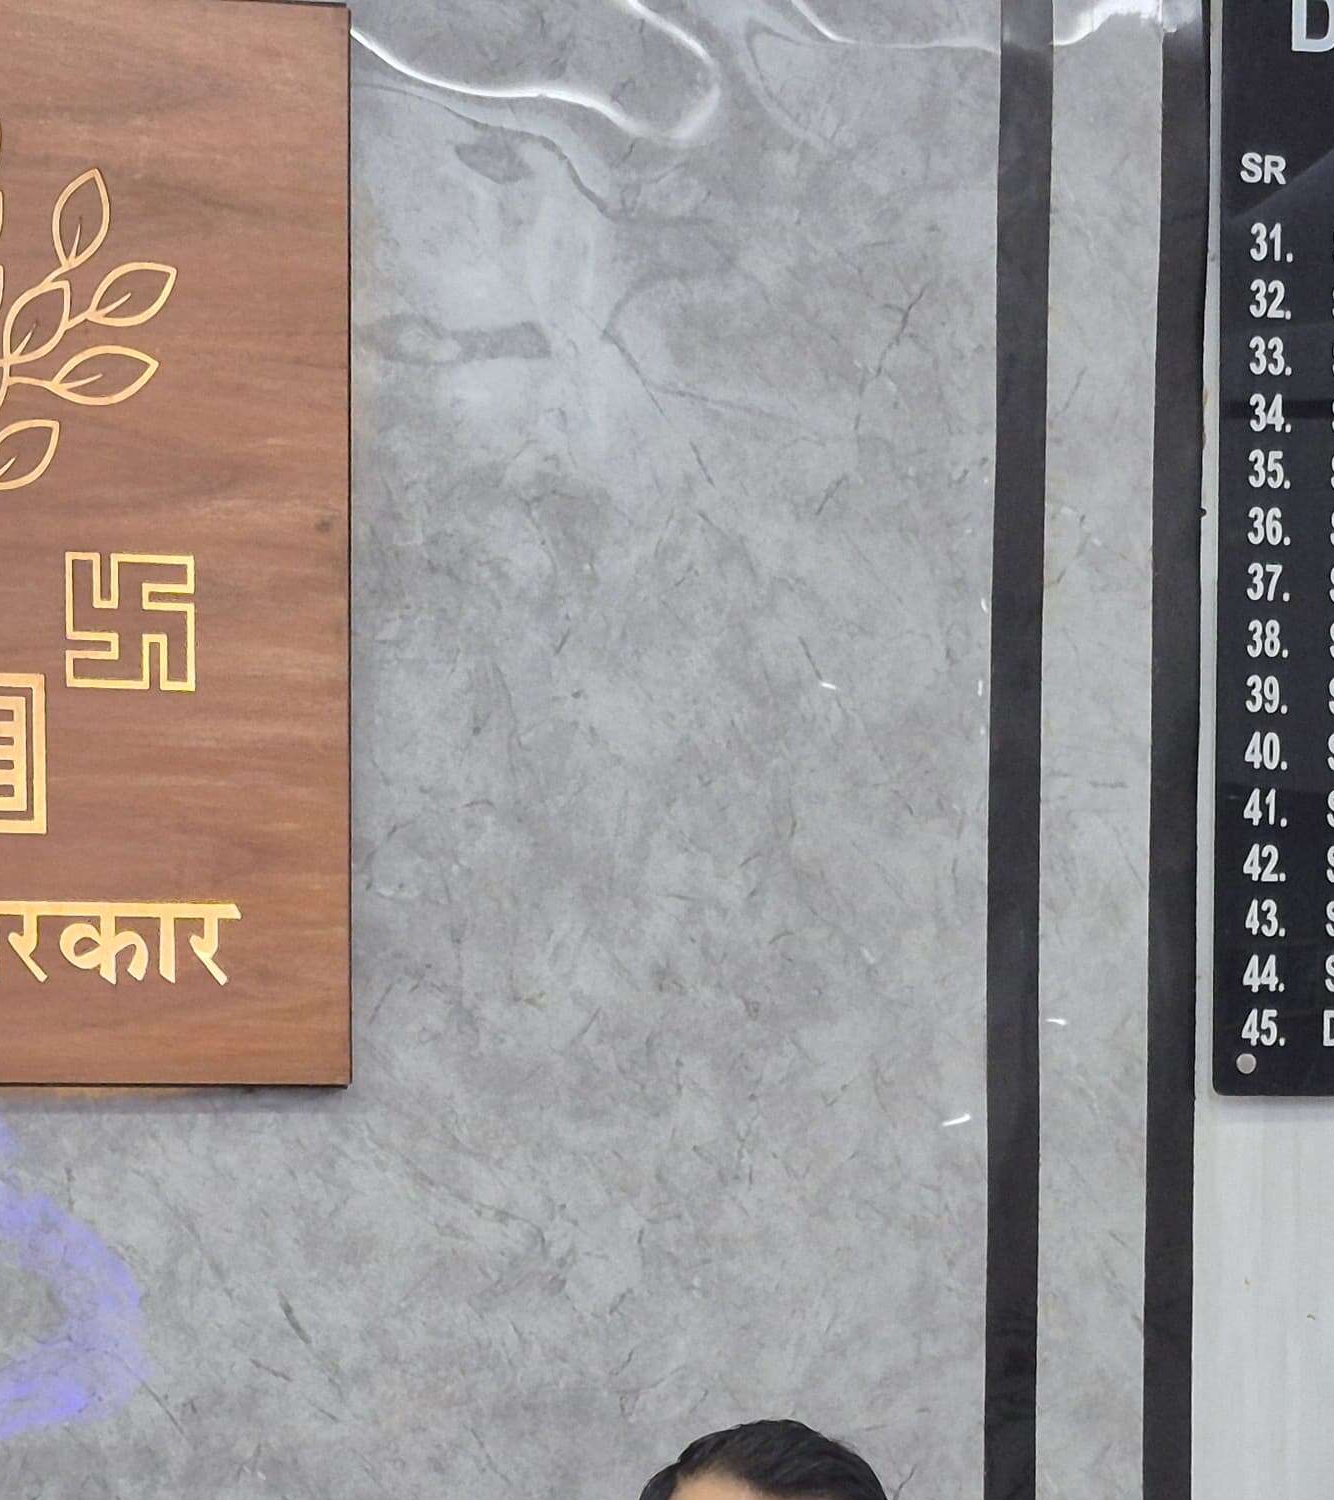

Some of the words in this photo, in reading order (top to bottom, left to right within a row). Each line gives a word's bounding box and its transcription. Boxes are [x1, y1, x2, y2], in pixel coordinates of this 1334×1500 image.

[1240, 152, 1286, 184] SR
[1250, 222, 1293, 262] 31.
[1250, 279, 1291, 320] 32.
[1249, 449, 1290, 489] 35.
[1247, 619, 1288, 658] 38.
[1242, 1008, 1285, 1046] 45.
